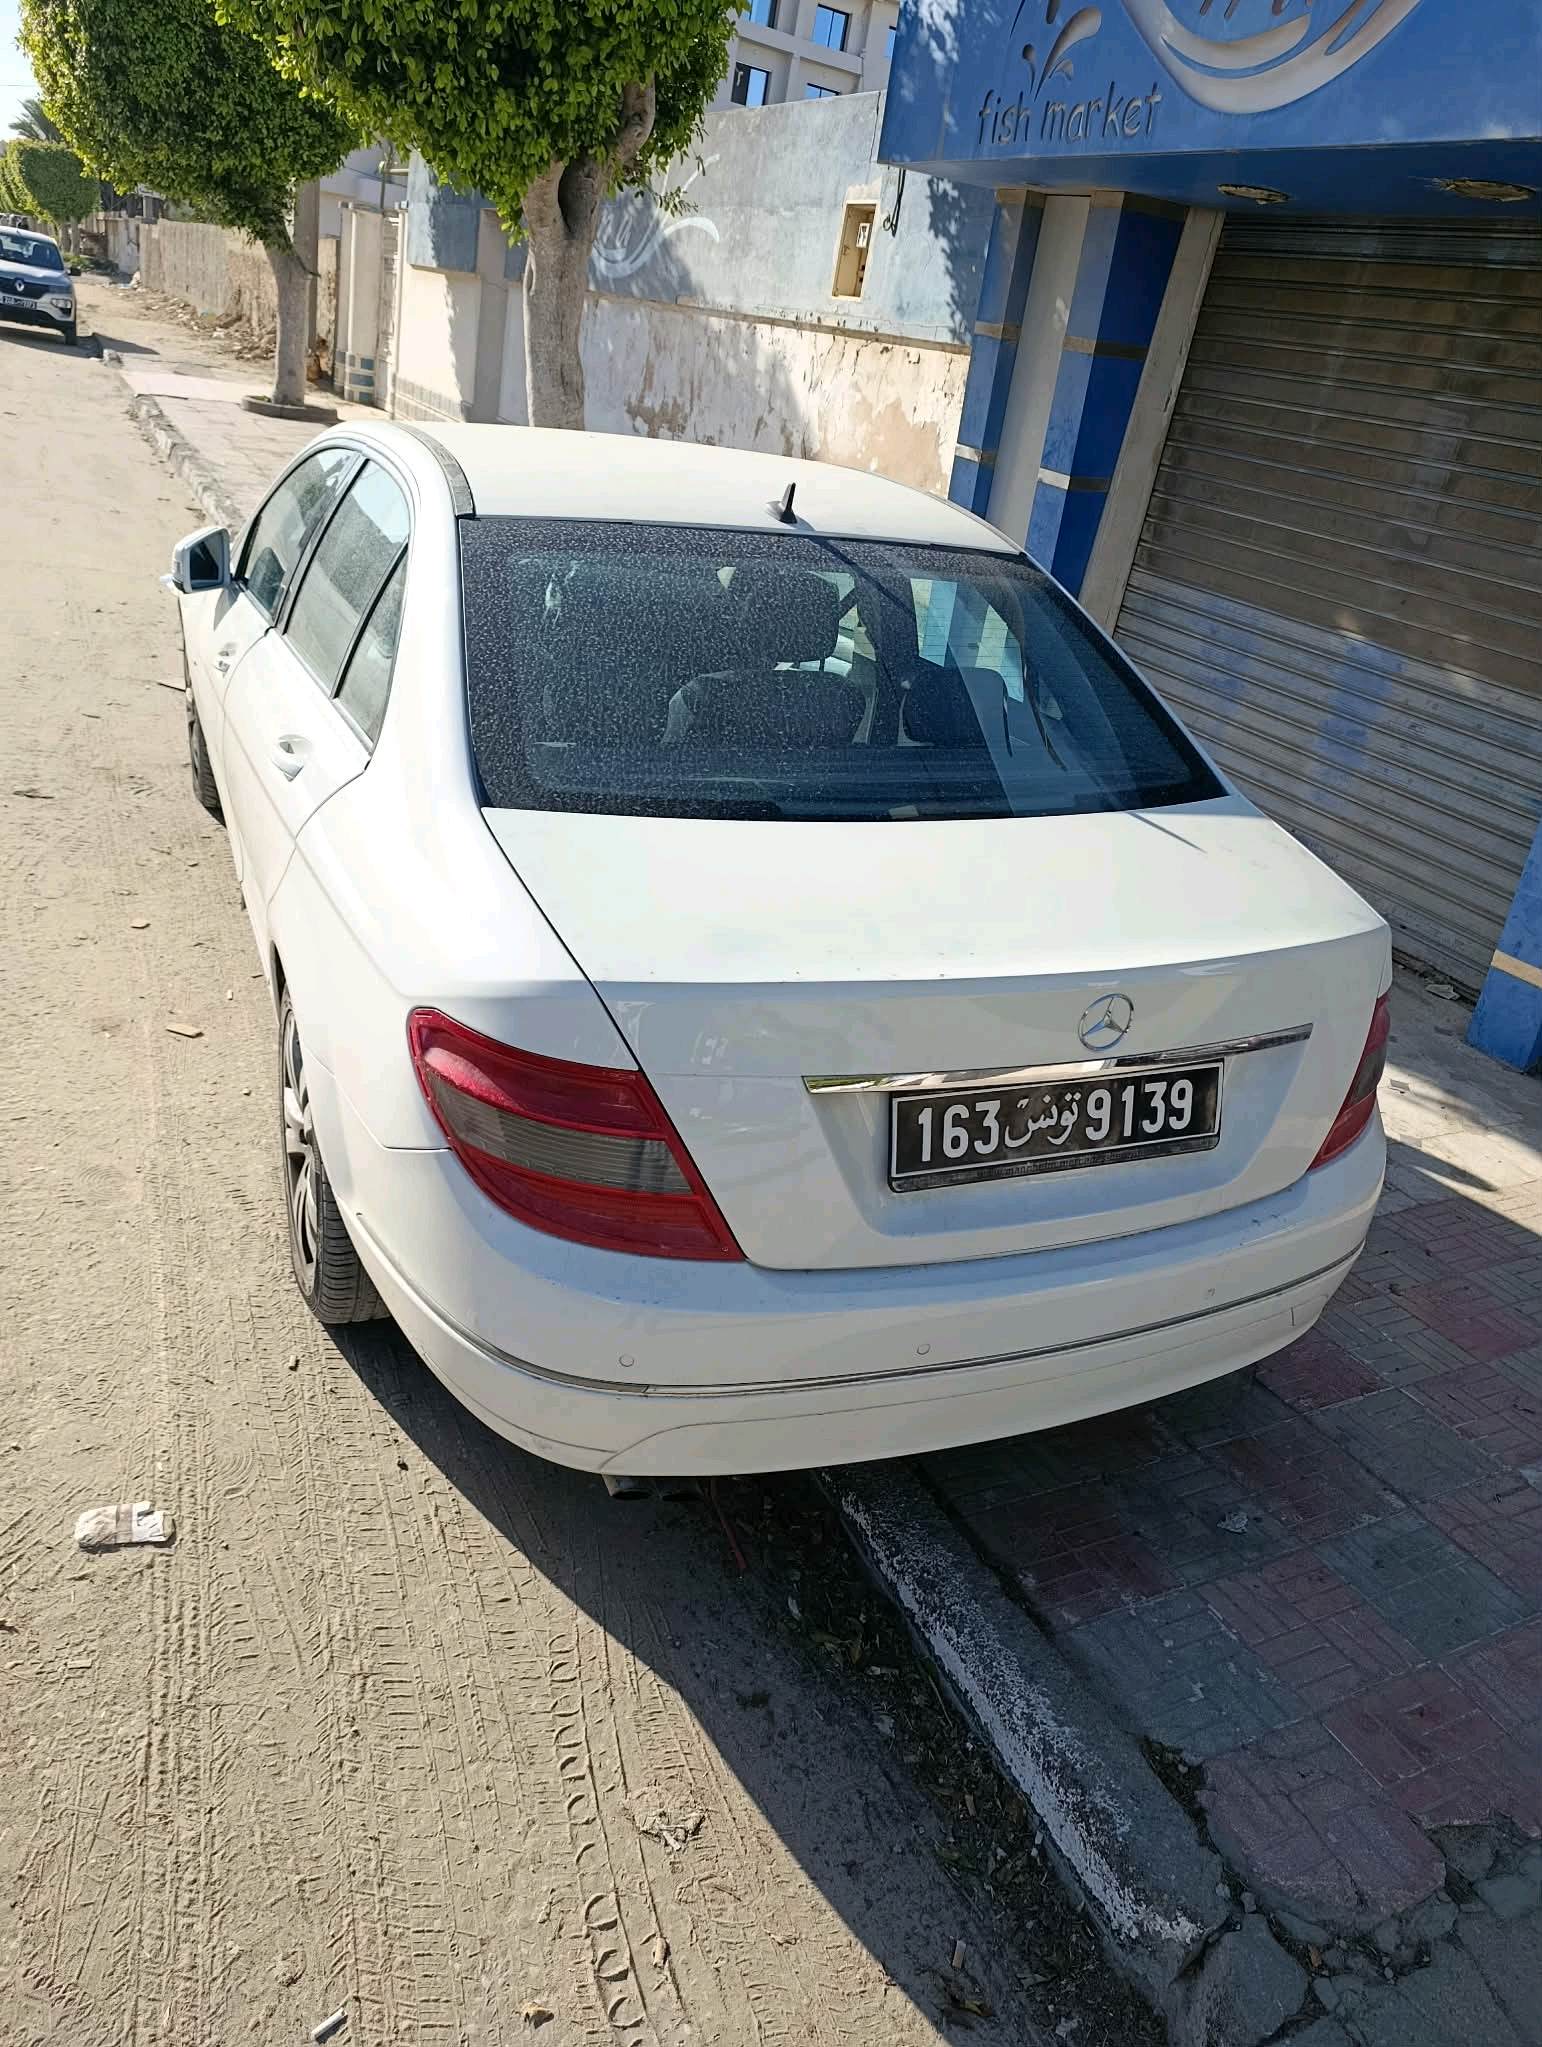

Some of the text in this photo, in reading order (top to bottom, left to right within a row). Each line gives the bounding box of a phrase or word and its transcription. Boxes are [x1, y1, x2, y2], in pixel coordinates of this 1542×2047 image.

[978, 81, 1163, 144] fish market
[918, 1078, 1194, 1162] 163 تونس 9139
